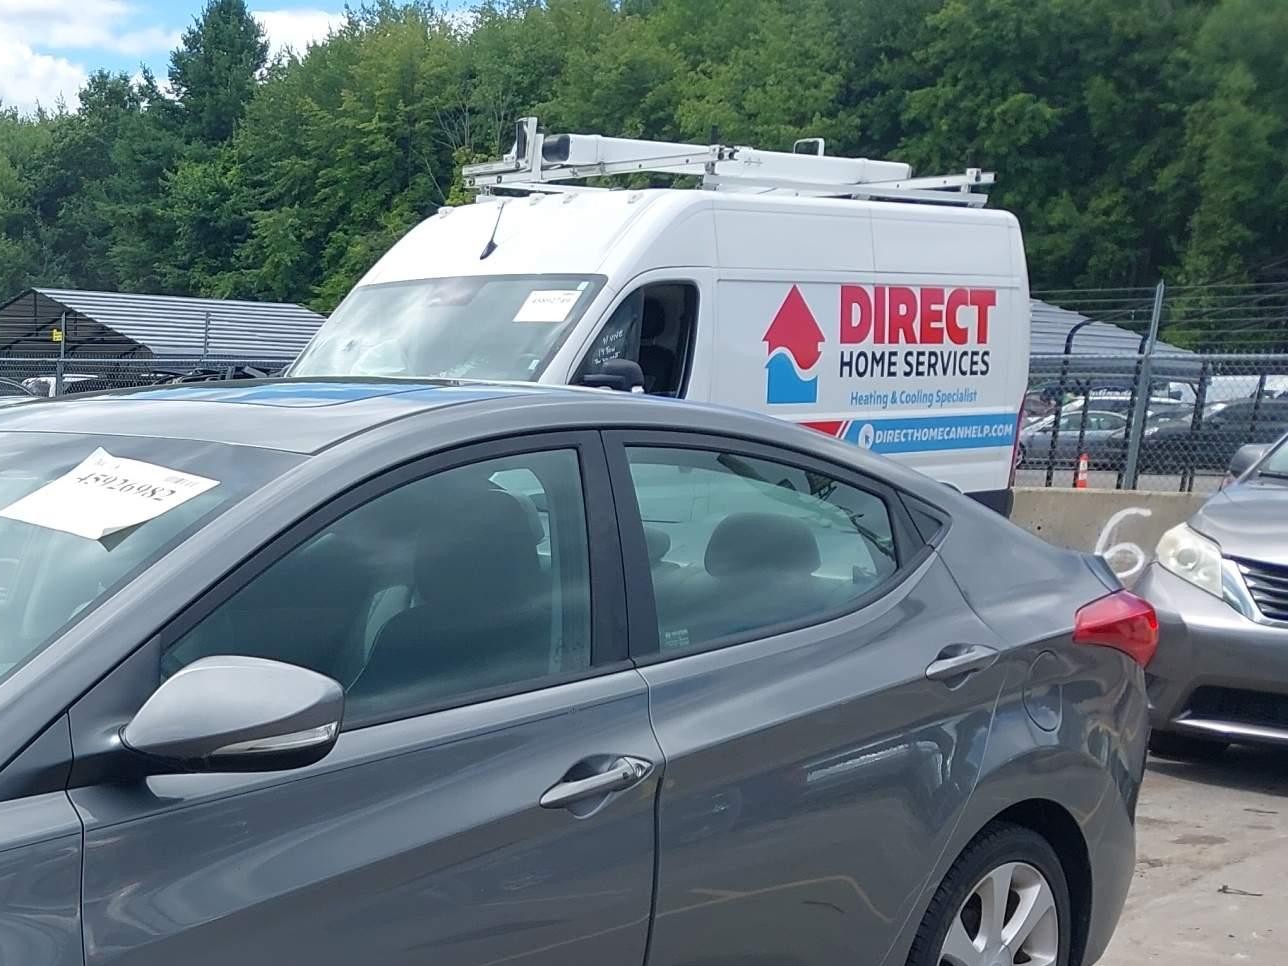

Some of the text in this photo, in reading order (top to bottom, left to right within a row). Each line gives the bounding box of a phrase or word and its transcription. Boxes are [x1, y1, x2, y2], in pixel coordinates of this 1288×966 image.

[839, 284, 997, 345] DIRECT
[839, 350, 990, 378] HOME SERVICES
[850, 389, 978, 409] Heating & Cooling Specialist
[875, 423, 1013, 444] DIRECTHOMECANHELP.COM
[76, 472, 177, 501] 45926982
[1094, 507, 1152, 578] 6
